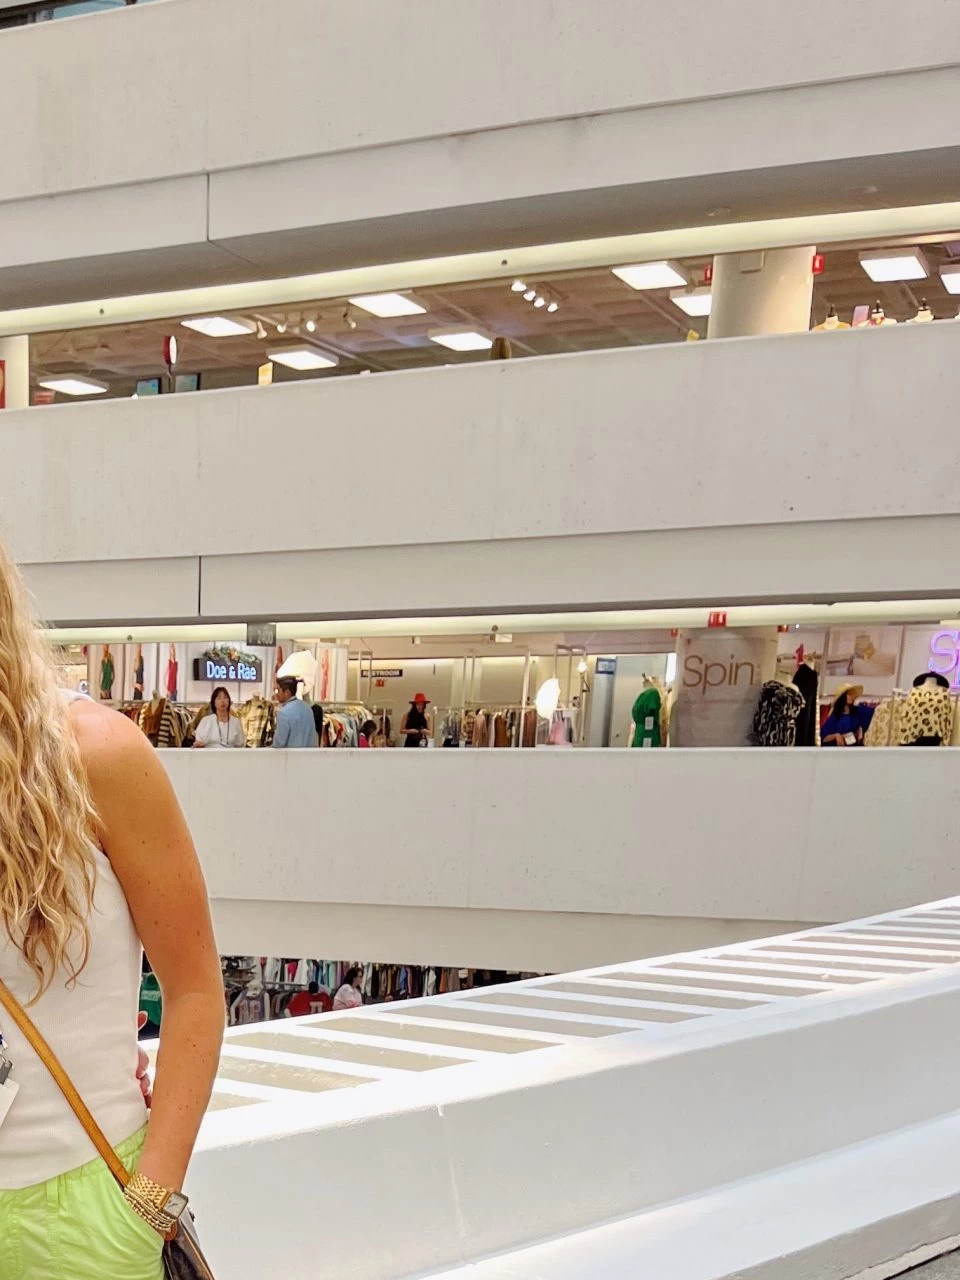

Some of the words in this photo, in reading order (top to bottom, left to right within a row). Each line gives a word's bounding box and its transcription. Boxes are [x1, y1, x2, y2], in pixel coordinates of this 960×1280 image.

[206, 661, 227, 679] Doe
[229, 665, 236, 679] &
[237, 662, 256, 680] Rae
[682, 654, 754, 695] Spin
